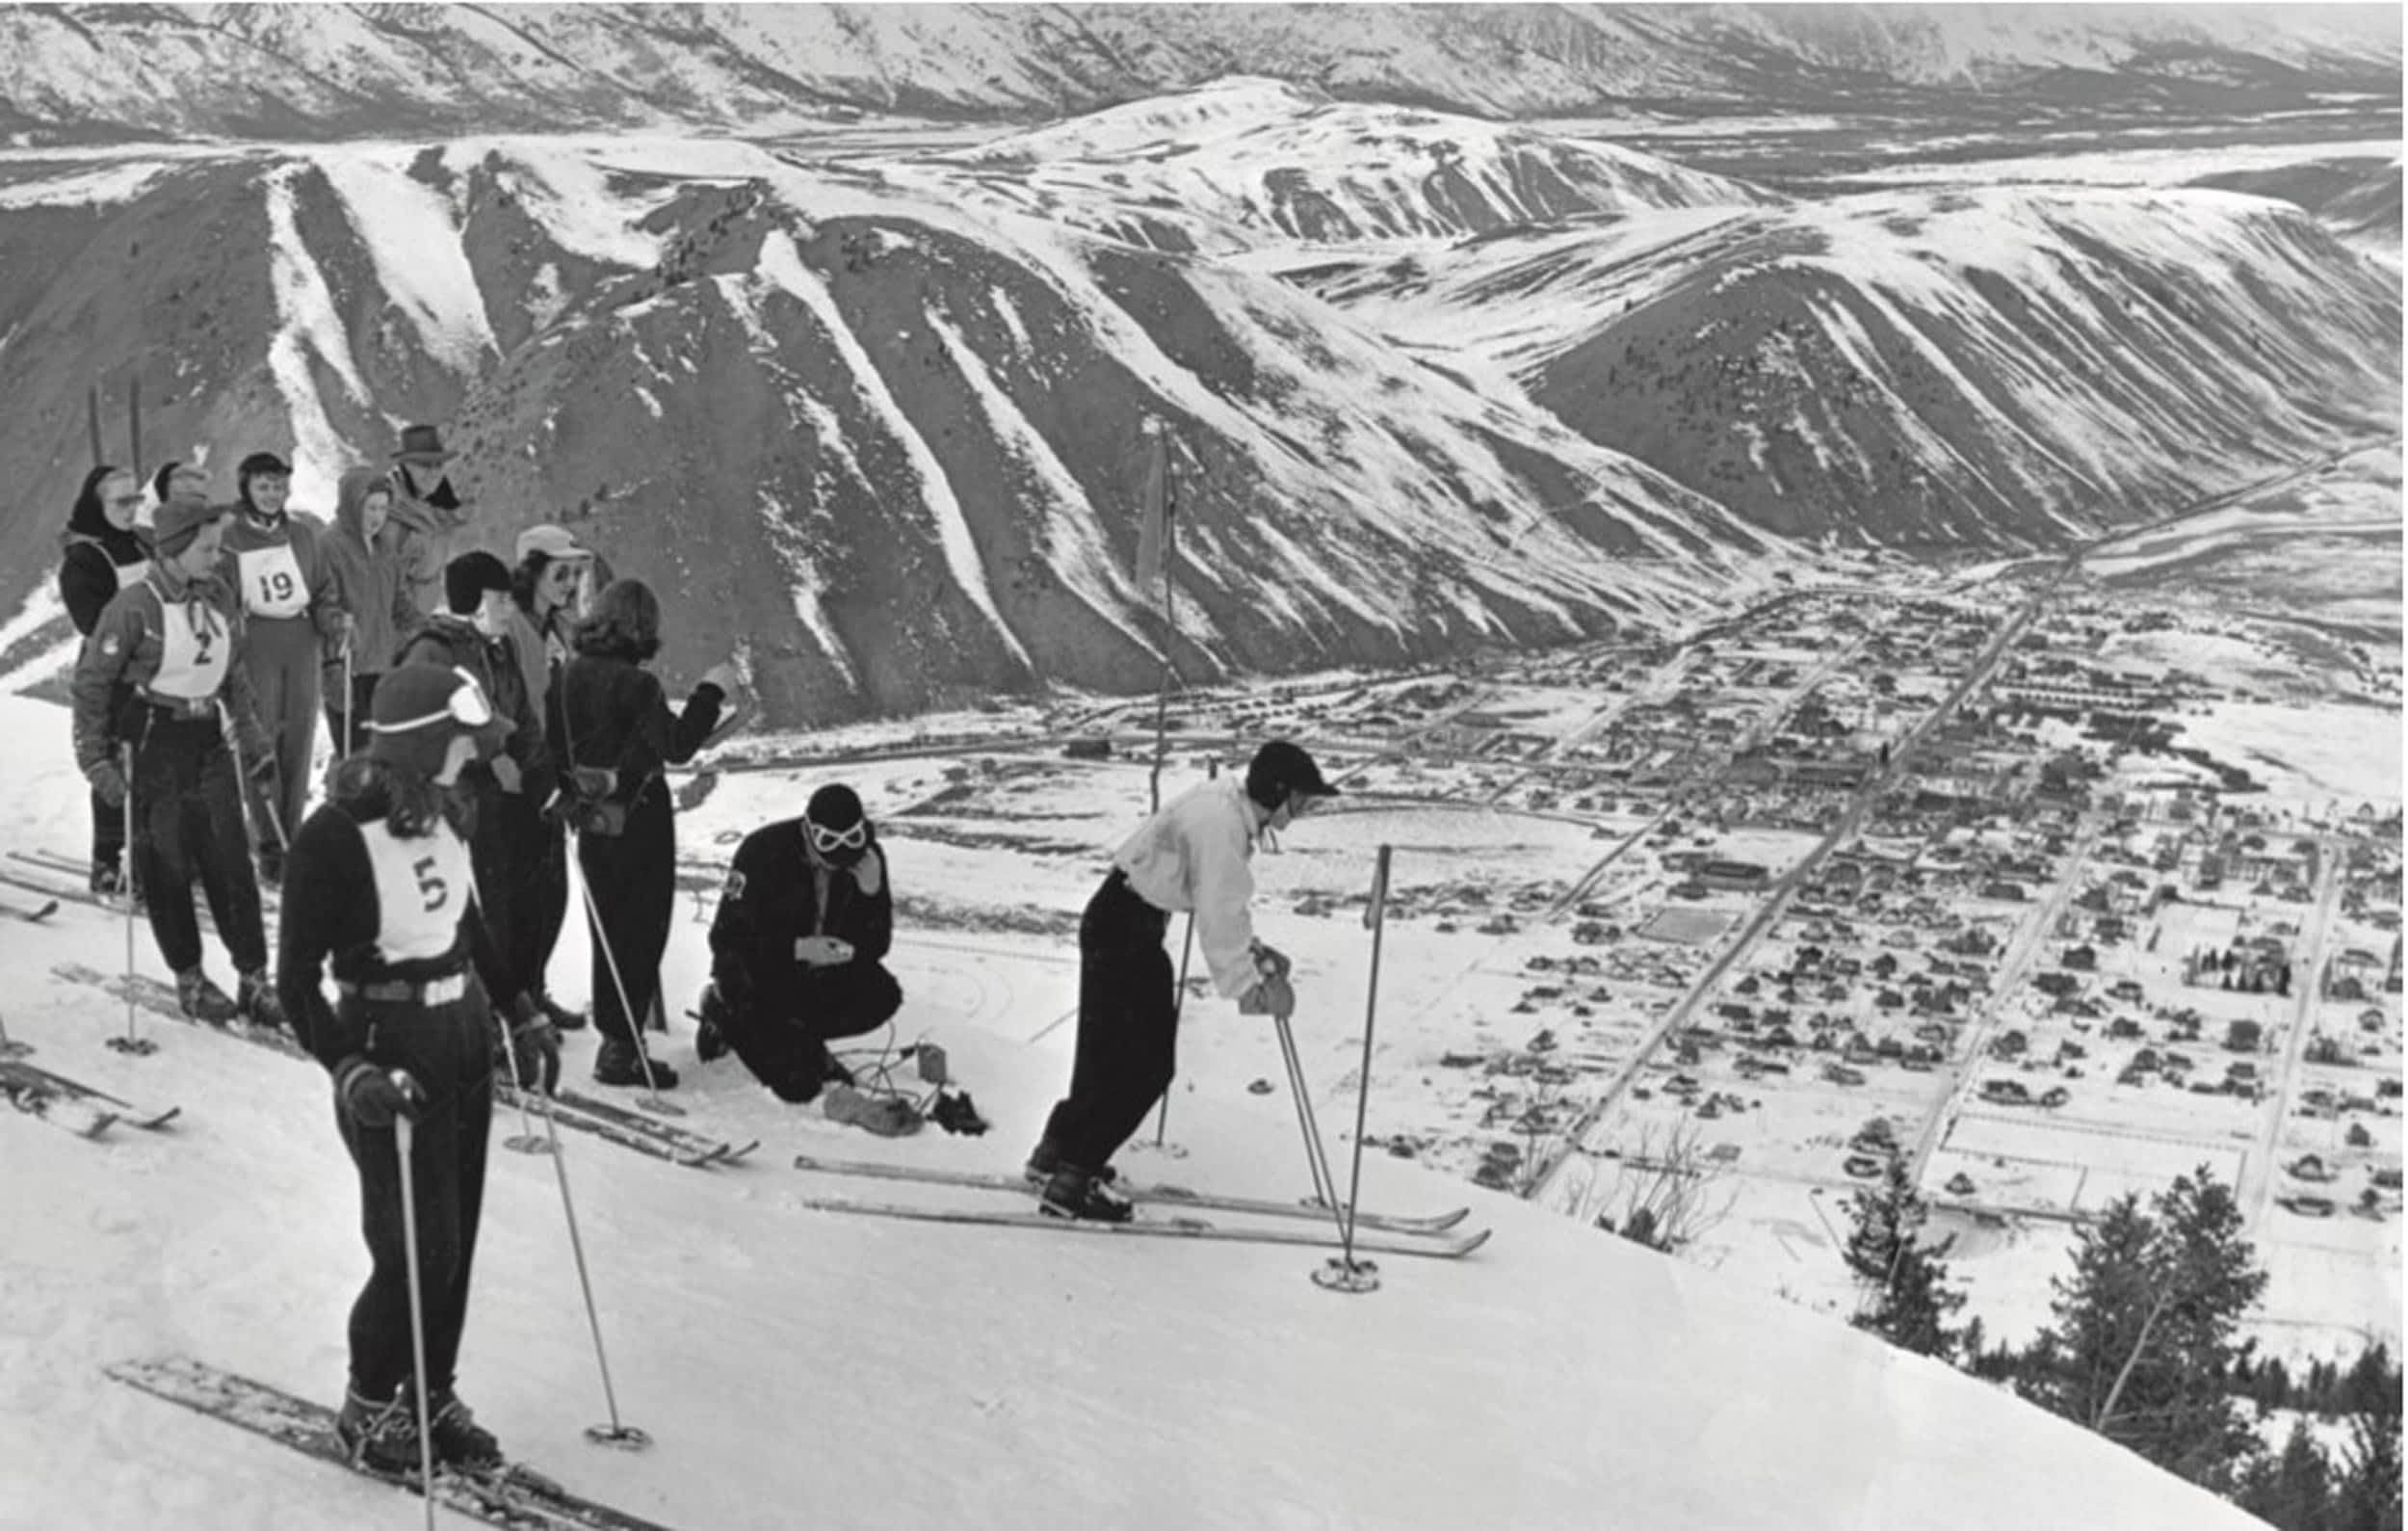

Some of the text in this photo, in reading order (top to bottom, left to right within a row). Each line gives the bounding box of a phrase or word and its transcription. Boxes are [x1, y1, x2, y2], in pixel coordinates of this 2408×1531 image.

[259, 572, 293, 603] 19
[195, 632, 212, 666] 2
[413, 857, 447, 912] 5
